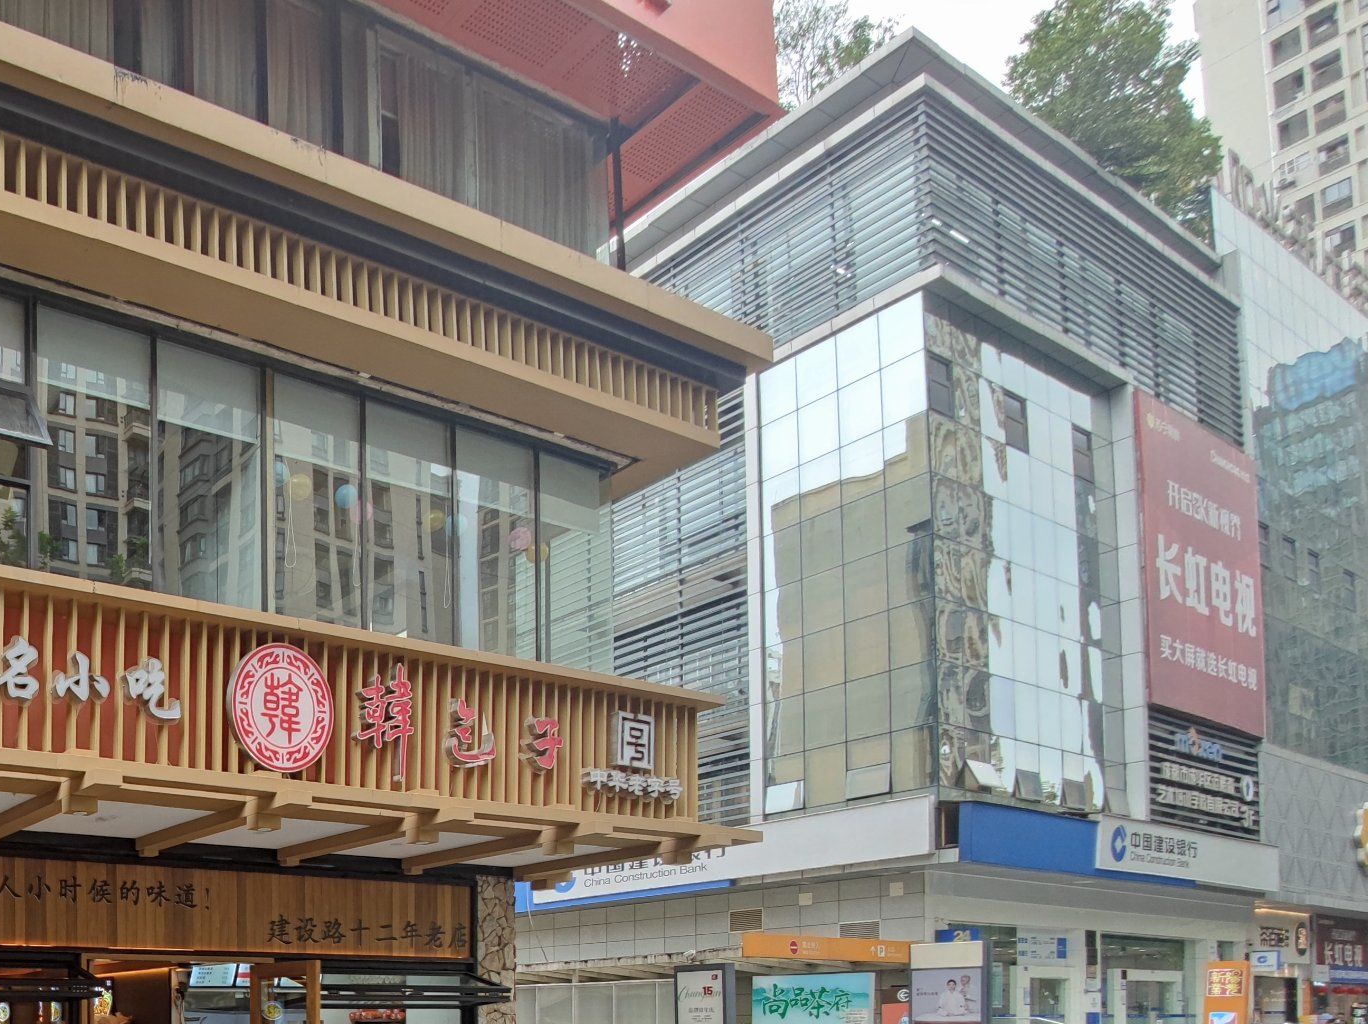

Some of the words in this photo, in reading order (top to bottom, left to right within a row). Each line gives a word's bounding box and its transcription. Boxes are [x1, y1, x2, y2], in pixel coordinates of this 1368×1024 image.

[1155, 533, 1257, 637] 长虹电视
[1159, 634, 1258, 691] 买大屏就选长虹电视
[1130, 832, 1199, 859] 中国建设银行
[1130, 851, 1146, 863] China
[584, 876, 611, 888] China
[614, 868, 677, 884] Construction
[679, 862, 707, 875] Bank
[265, 914, 469, 953] 建设路十二年老店
[1324, 941, 1364, 967] 长虹电视
[762, 983, 853, 1019] 尚品茶府
